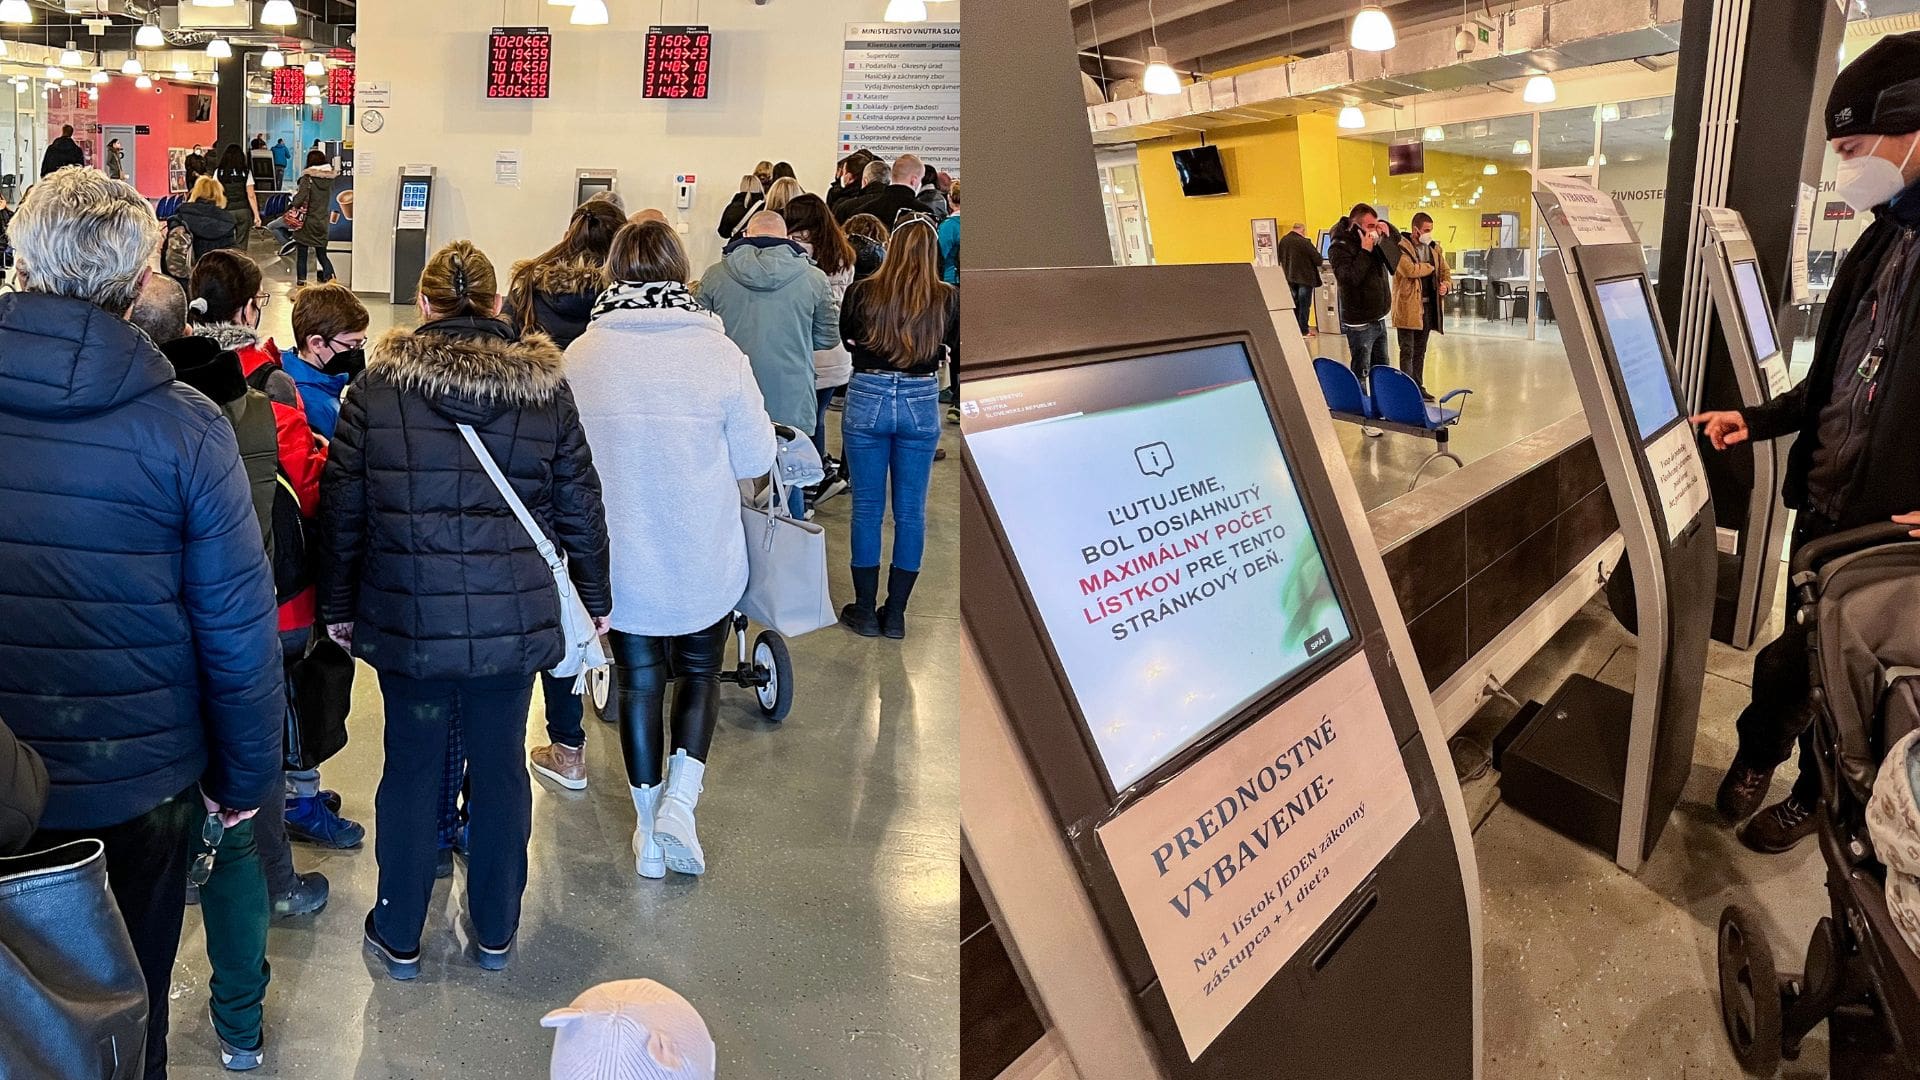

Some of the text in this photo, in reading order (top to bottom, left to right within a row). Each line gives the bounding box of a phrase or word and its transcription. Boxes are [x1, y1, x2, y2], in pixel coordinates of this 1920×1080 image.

[1611, 189, 1666, 200] ŽIVNOSTE
[1081, 484, 1262, 566] BOL DOSIAHNUTÝ
[1108, 476, 1226, 527] ĽUTUJEME,
[1078, 505, 1274, 596] MAXIMÁLNY POČET
[1083, 524, 1286, 625] LÍSTKOV PRE TENTO
[1111, 550, 1284, 642] STRÁNKOVÝ DEŇ.
[1150, 714, 1337, 877] PREDNOSTNÉ
[1168, 774, 1335, 920] VYBAVENIE-
[1192, 800, 1368, 972] Na 1 lístok JEDEN zákonný
[1202, 865, 1331, 996] zástupca + 1 dieťa
